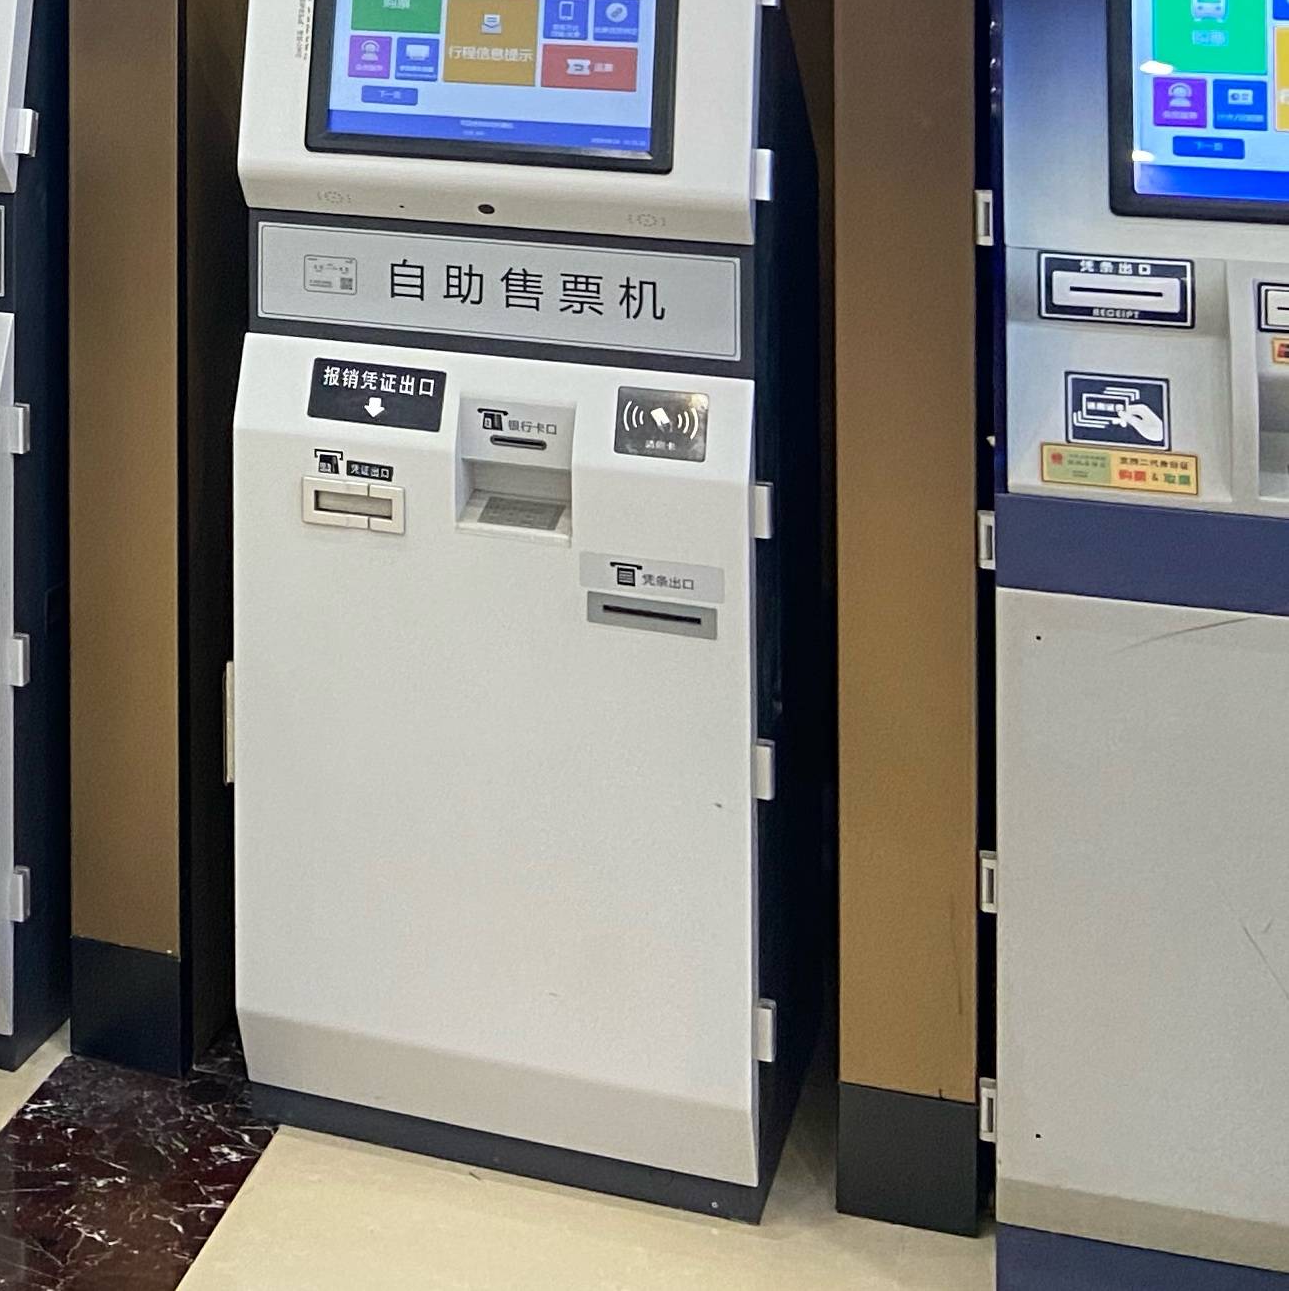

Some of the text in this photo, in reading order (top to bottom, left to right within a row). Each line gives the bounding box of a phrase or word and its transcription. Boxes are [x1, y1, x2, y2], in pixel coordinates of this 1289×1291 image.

[390, 259, 666, 321] 自助售票机
[1092, 308, 1140, 319] RECEIPT
[323, 366, 435, 397] 报销凭证出口
[508, 419, 557, 435] 银行卡口
[350, 463, 390, 478] 凭证出口
[642, 573, 695, 591] 凭条出口
